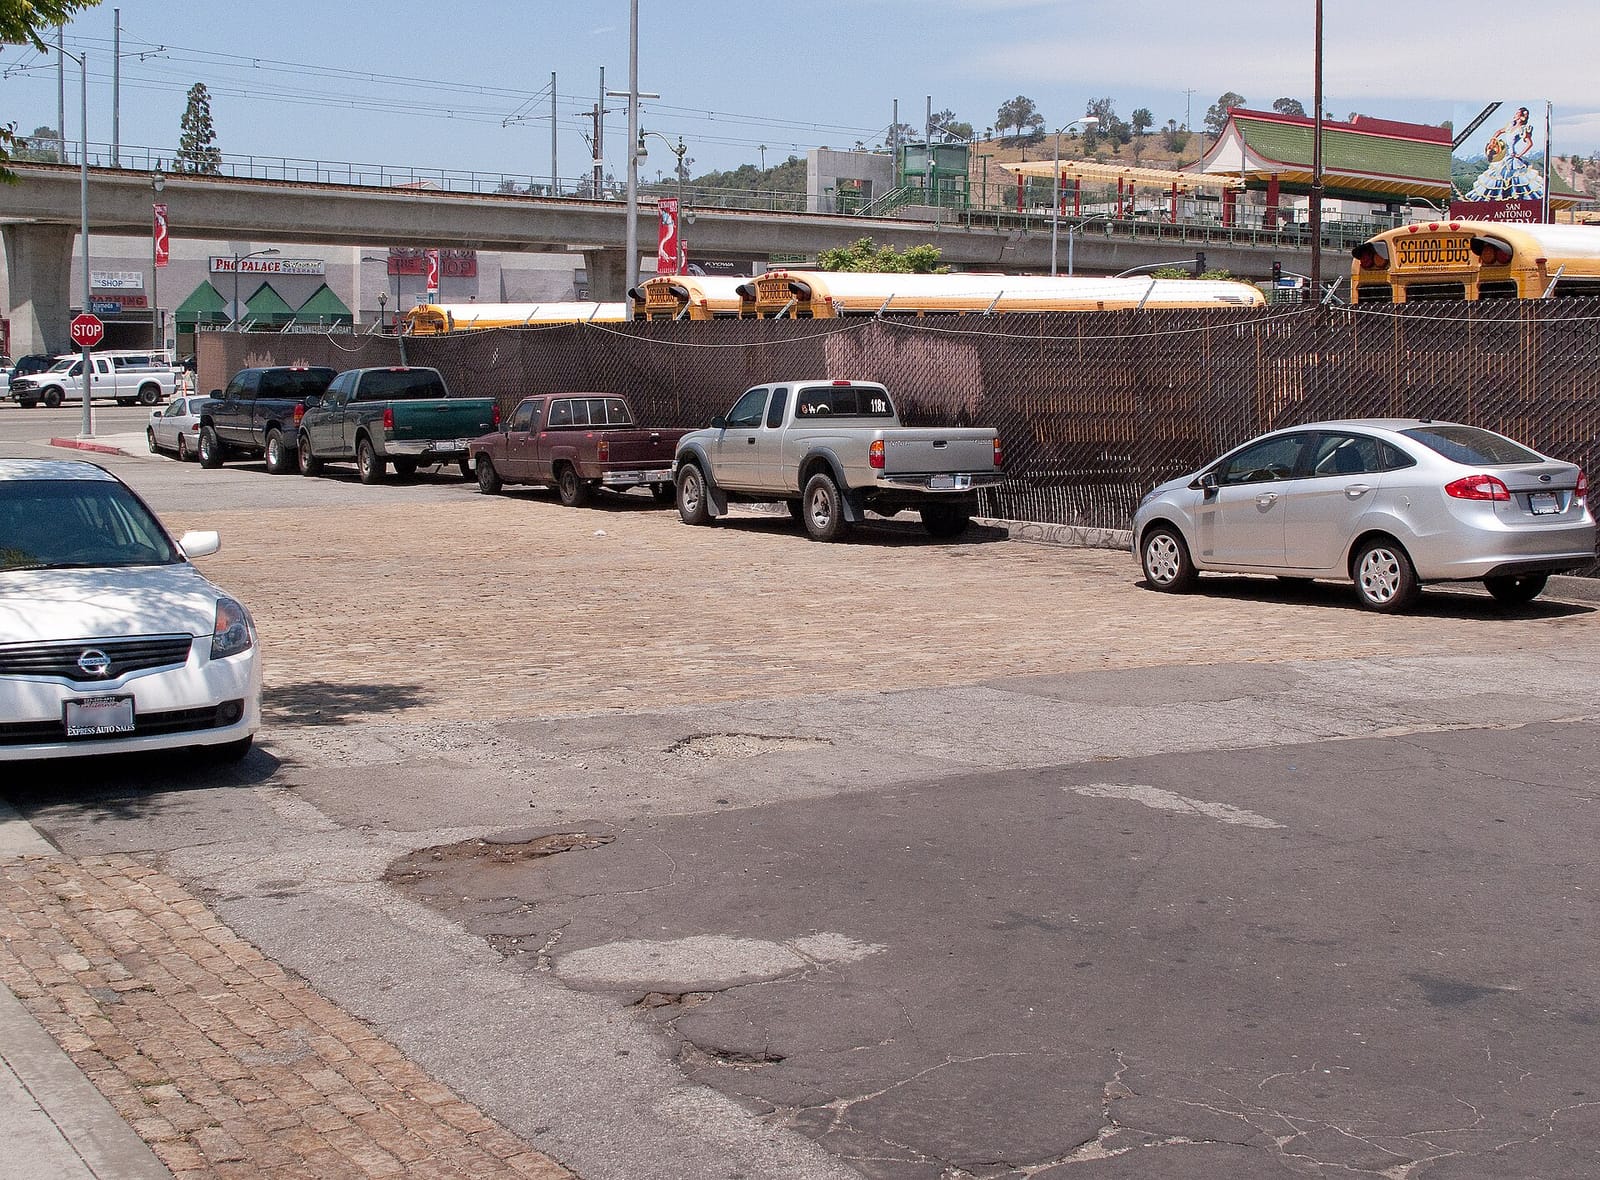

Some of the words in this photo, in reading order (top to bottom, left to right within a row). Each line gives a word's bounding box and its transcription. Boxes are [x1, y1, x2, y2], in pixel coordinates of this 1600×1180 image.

[1494, 210, 1532, 219] ANTONIO
[1400, 240, 1445, 264] SCHOOL
[1446, 239, 1470, 262] BUS
[216, 259, 237, 270] PHO
[241, 261, 281, 272] PALACE
[101, 279, 123, 287] SHOP
[73, 324, 102, 337] STOP
[67, 726, 96, 736] EXPRESS
[96, 726, 115, 734] AUTO
[115, 724, 136, 732] SALES
